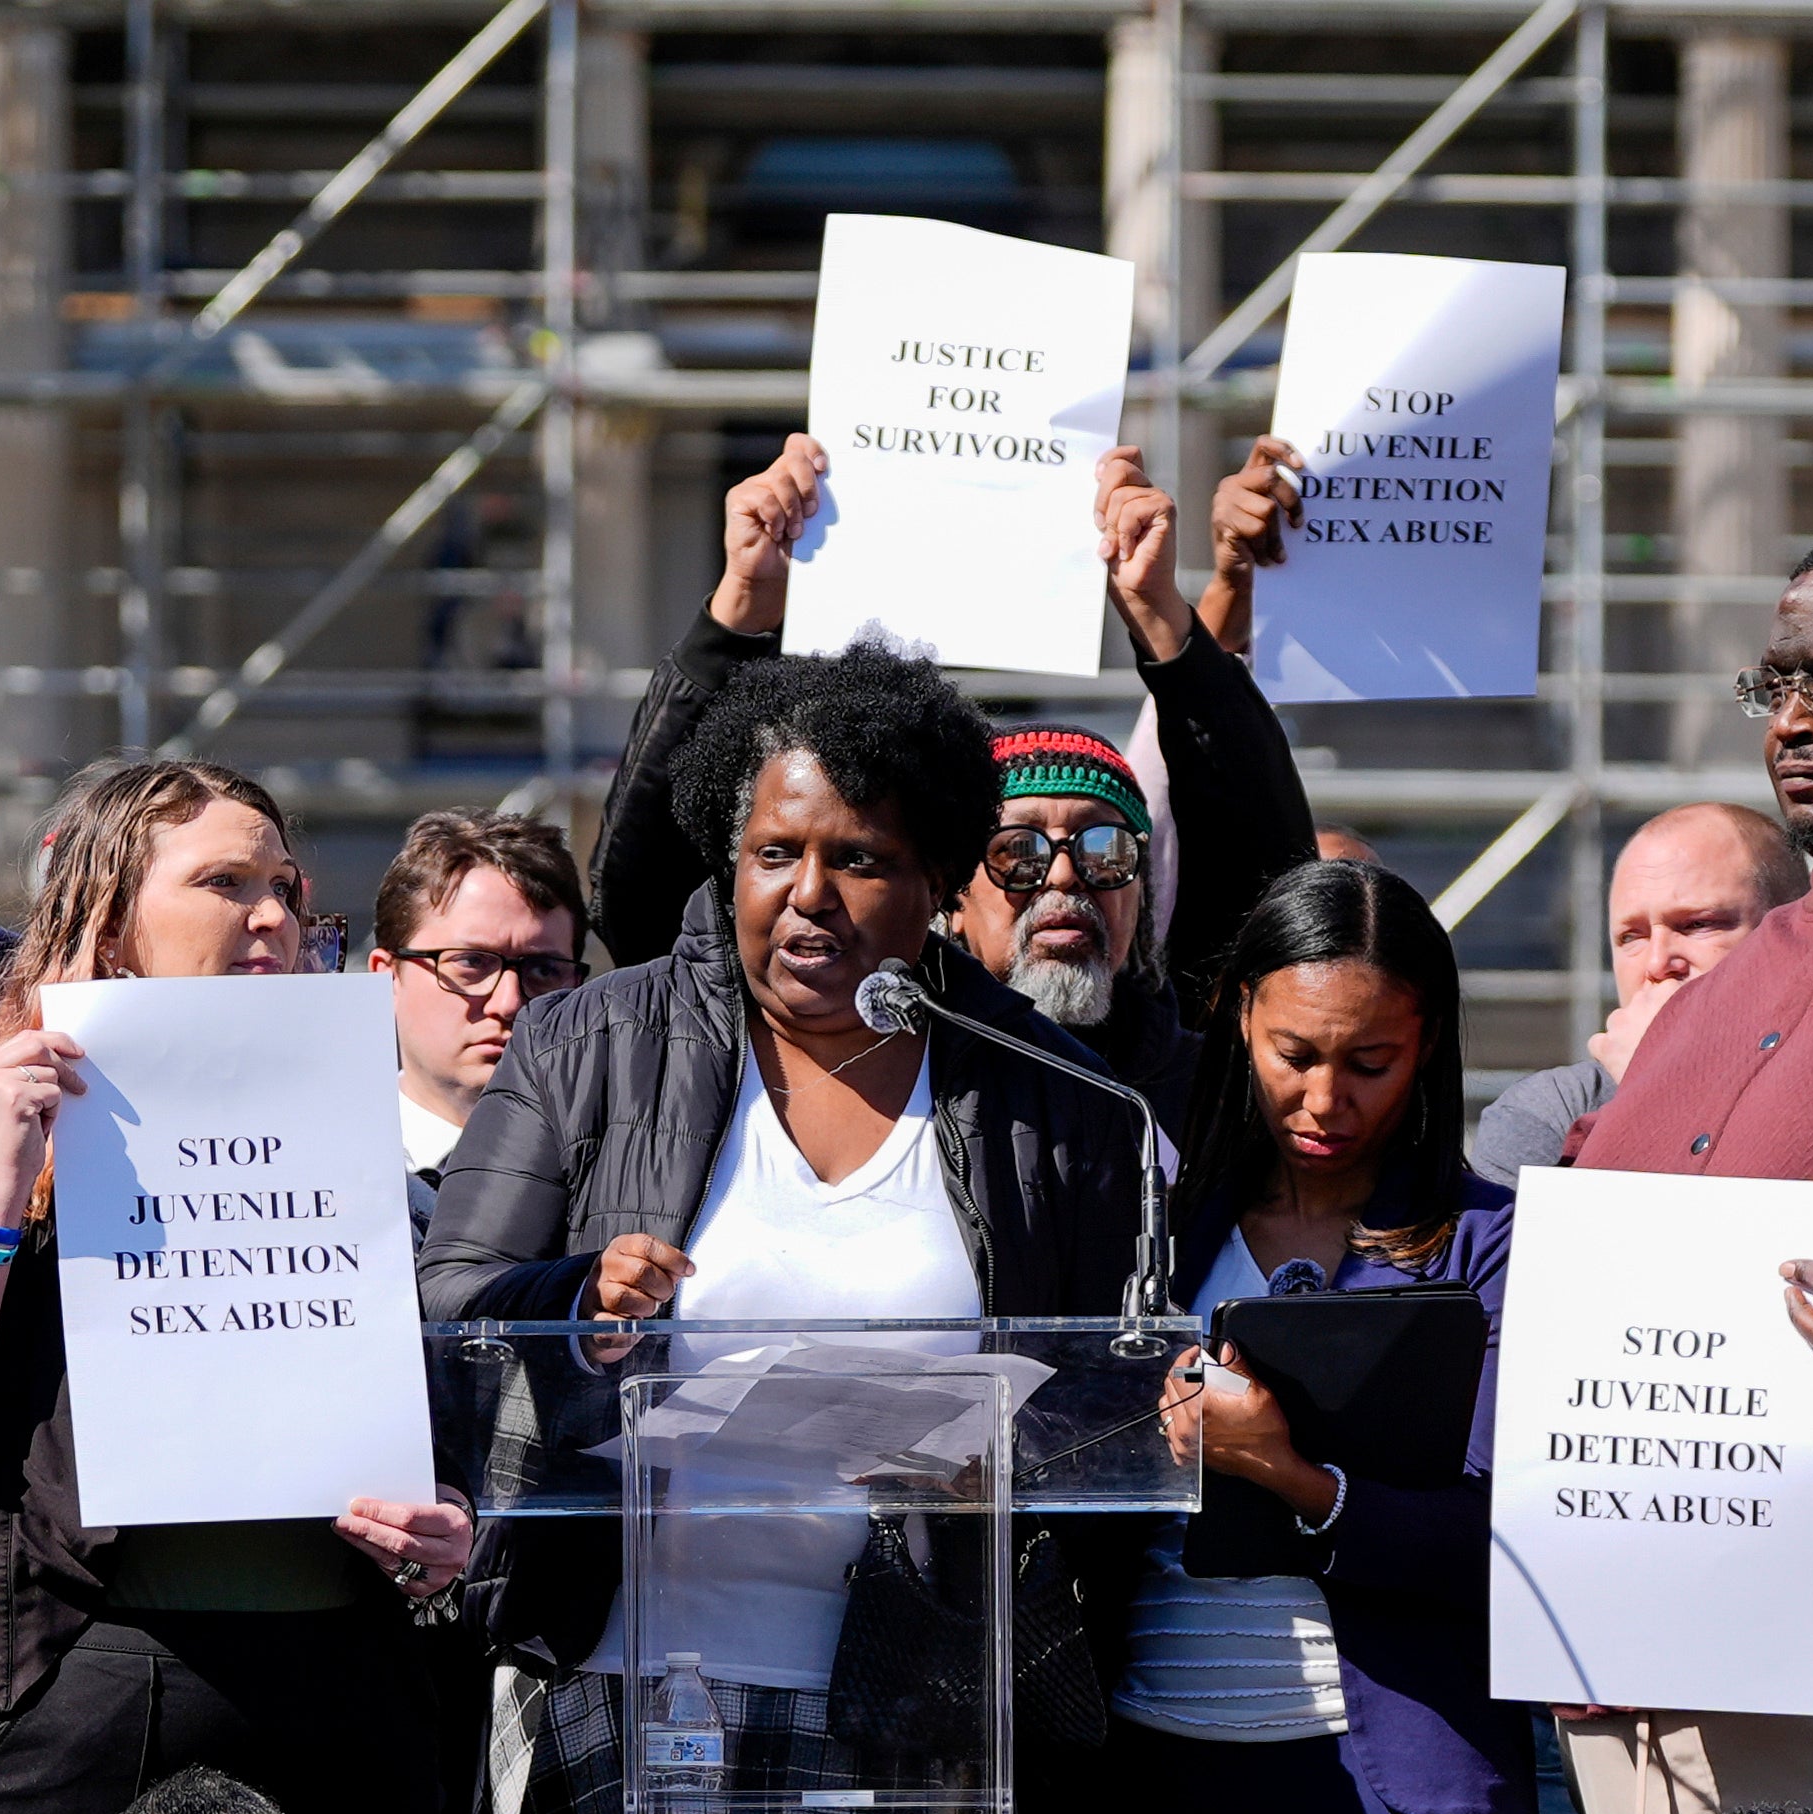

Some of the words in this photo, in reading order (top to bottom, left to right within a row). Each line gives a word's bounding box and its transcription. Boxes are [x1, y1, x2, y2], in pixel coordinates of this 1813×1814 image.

[890, 340, 1045, 373] JUSTICE
[930, 387, 999, 412] FOR
[1363, 387, 1455, 416] STOP
[852, 423, 1066, 466] SURVIVORS
[1315, 430, 1492, 462] JUVENILE
[1300, 474, 1505, 503] DETENTION
[1305, 519, 1370, 543] SEX
[1379, 520, 1492, 543] ABUSE
[179, 1137, 281, 1167] STOP
[129, 1190, 336, 1225] JUVENILE
[113, 1245, 358, 1279] DETENTION
[131, 1305, 208, 1334] SEX
[222, 1299, 355, 1331] ABUSE
[1624, 1327, 1726, 1358] STOP
[1568, 1379, 1767, 1416] JUVENILE
[1549, 1433, 1784, 1472] DETENTION
[1557, 1489, 1629, 1519] SEX
[1642, 1496, 1771, 1527] ABUSE
